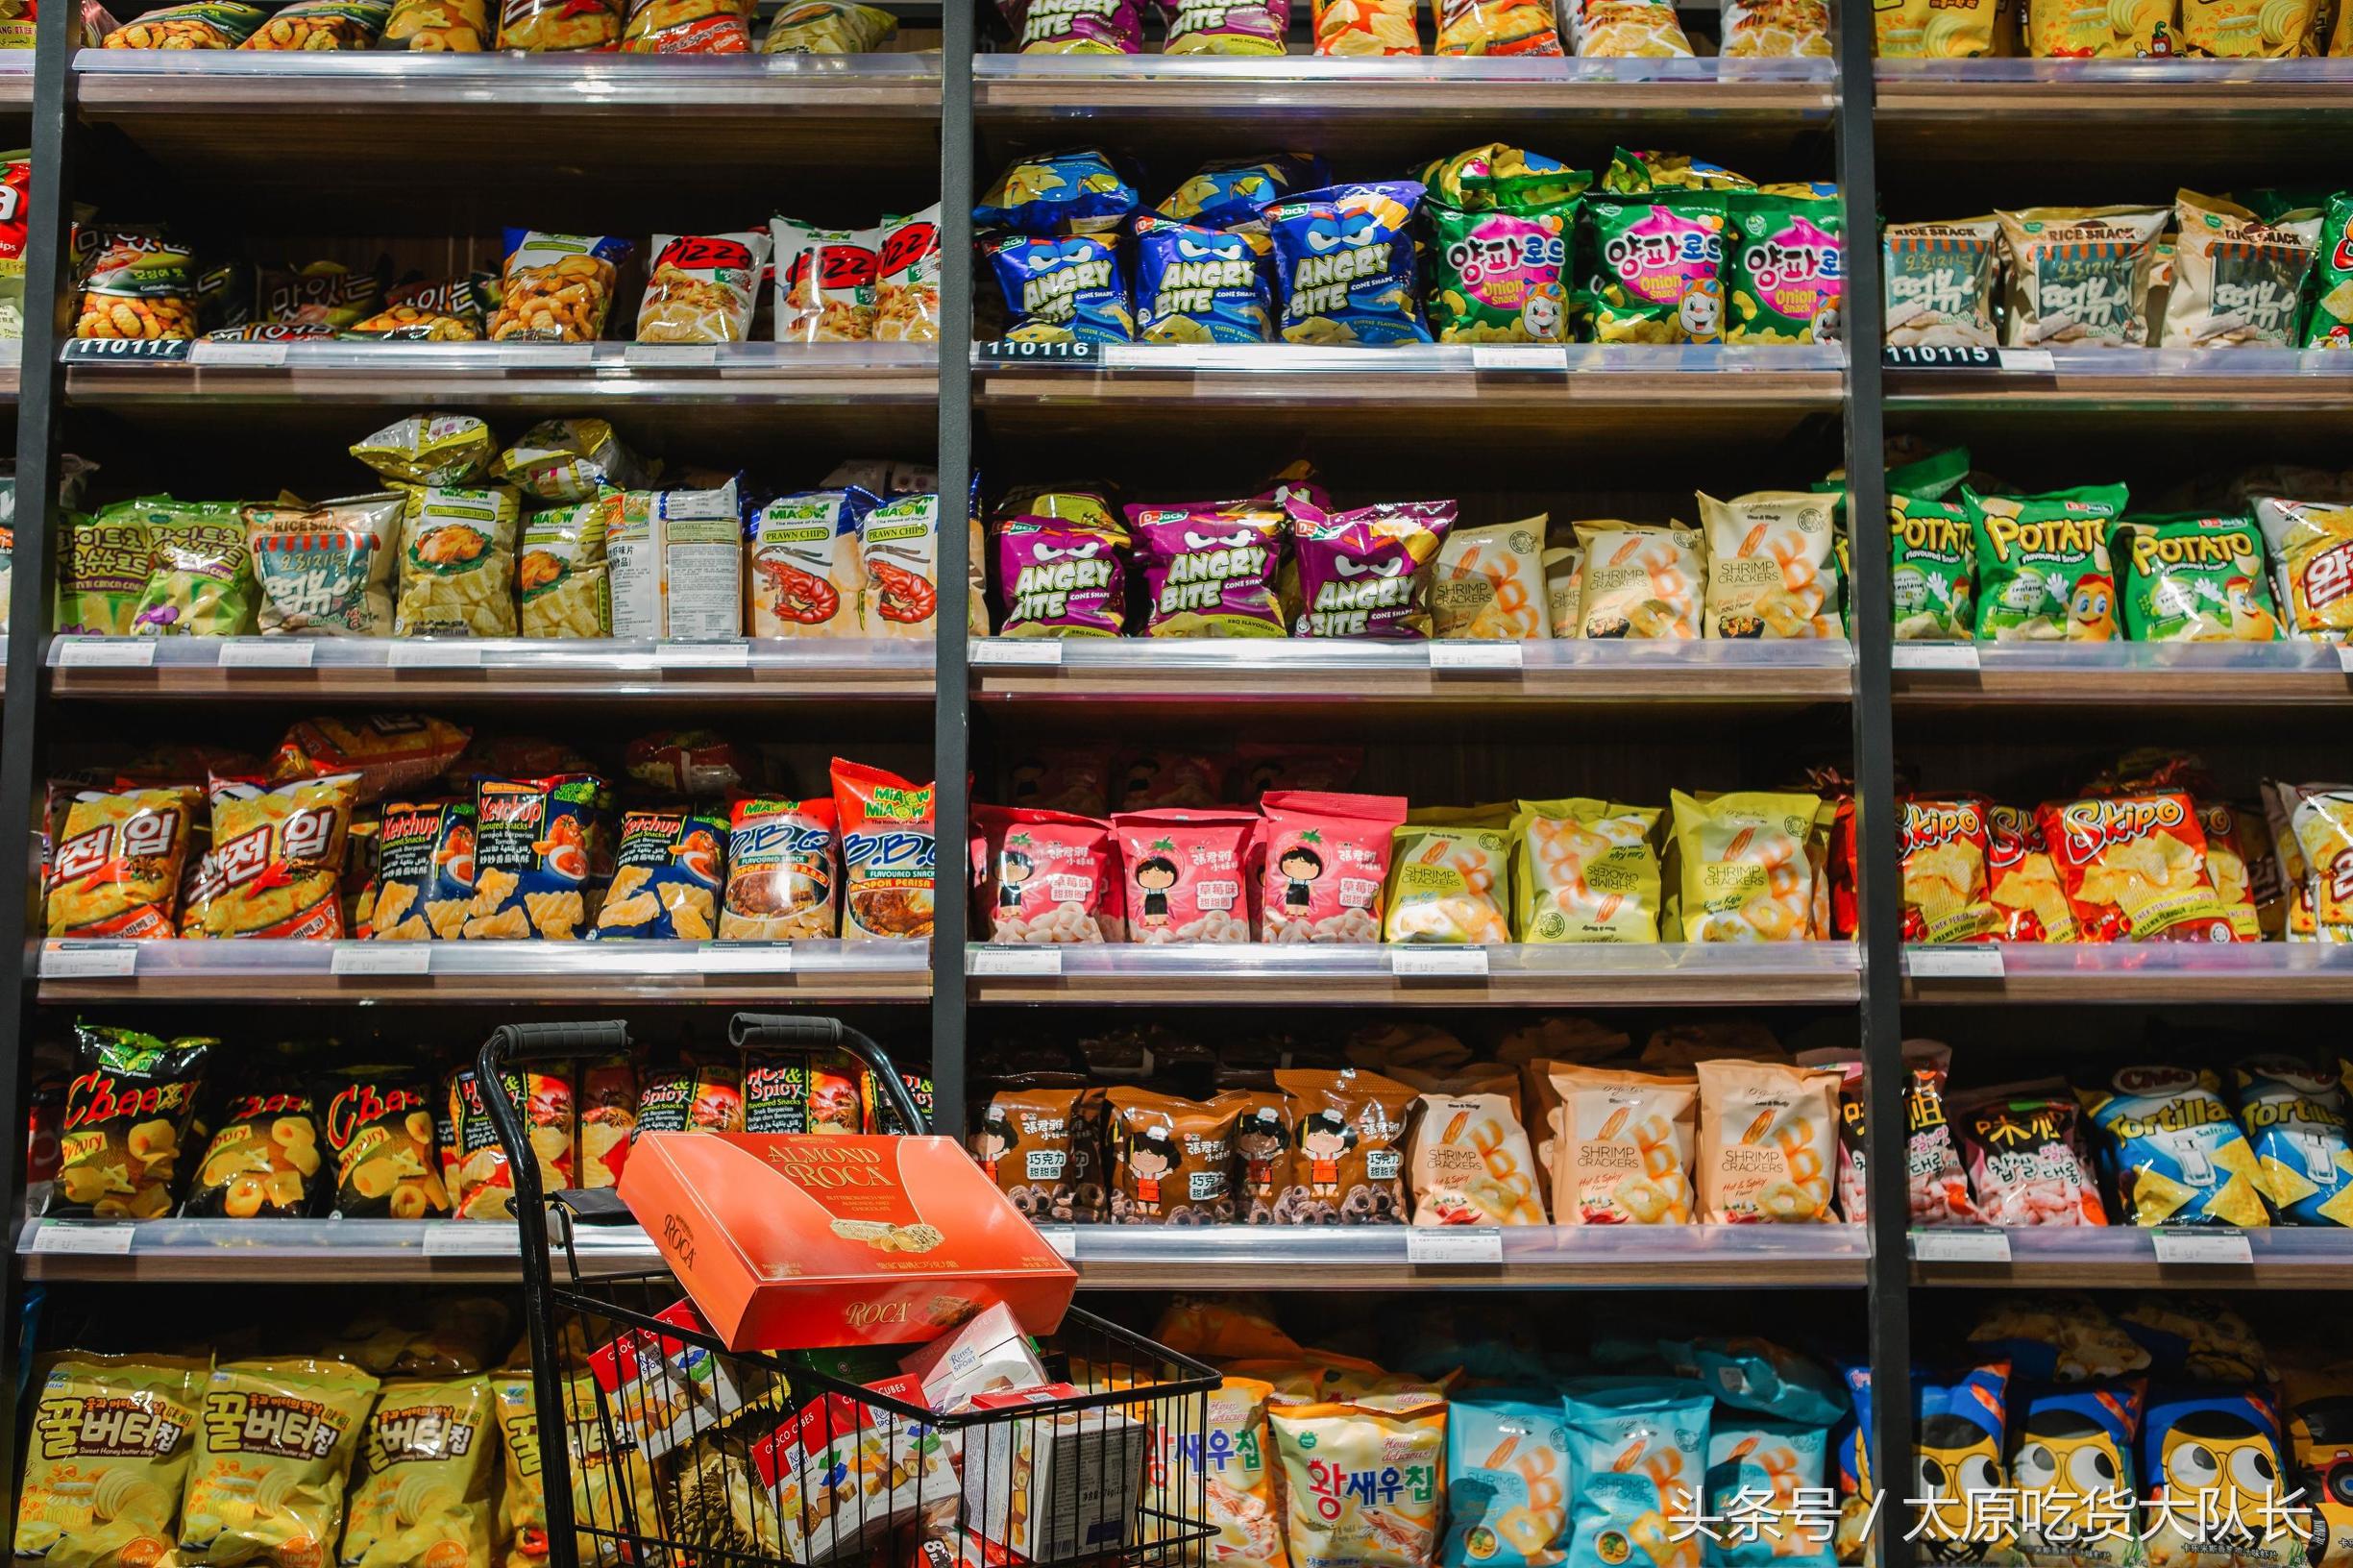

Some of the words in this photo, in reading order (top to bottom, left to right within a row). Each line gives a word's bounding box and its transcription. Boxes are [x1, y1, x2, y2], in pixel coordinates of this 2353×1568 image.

[2048, 229, 2082, 241] RICE
[1294, 243, 1392, 289] ANGRY
[1160, 261, 1255, 290] ANGRY
[1023, 260, 1114, 313] ANGRY
[1351, 281, 1372, 290] CONE
[1482, 281, 1524, 297] Onion
[1639, 275, 1682, 292] Onion
[1155, 289, 1213, 315] BITE
[1288, 282, 1348, 317] BITE
[1491, 292, 1520, 306] Snack
[1649, 287, 1678, 302] Snack
[1775, 289, 1818, 306] Onion
[1782, 303, 1812, 315] Snack
[987, 342, 1090, 356] 110116
[1885, 346, 1990, 362] 110115
[766, 531, 798, 541] PRAWN
[799, 529, 826, 539] CHIPS
[869, 528, 900, 540] PRAWN
[901, 526, 925, 536] CHIPS
[2022, 551, 2061, 564] Flavoured
[2063, 551, 2086, 562] Snack
[2132, 533, 2253, 576] POTATO
[1168, 546, 1268, 582] ANGRY
[1721, 561, 1775, 575] SHRIMP
[1016, 561, 1115, 593] ANGRY
[1589, 569, 1646, 582] SHRIMP
[1718, 573, 1778, 584] CRACKERS
[1225, 580, 1246, 589] CONE
[1437, 583, 1488, 597] SHRIMP
[1589, 578, 1648, 591] CRACKERS
[1160, 581, 1222, 612] BITE
[1315, 576, 1416, 611] ANGRY
[1434, 594, 1492, 606] CRACKERS
[874, 787, 931, 803] MIAOW
[480, 796, 542, 828] Ketchup
[866, 803, 926, 818] MIAOW
[382, 812, 439, 843] Ketchup
[625, 816, 680, 838] Ketchup
[2066, 797, 2184, 865] Skipo
[742, 855, 779, 864] FLAVOURED
[1405, 866, 1456, 880] SHRIMP
[1707, 865, 1761, 878] SHRIMP
[895, 879, 931, 888] PERISA
[1198, 881, 1238, 896] 草莓味
[1401, 875, 1460, 887] CRACKERS
[1589, 877, 1637, 892] SHRIMP
[1703, 875, 1764, 888] CRACKERS
[750, 1080, 802, 1100] Spicy
[1021, 1119, 1065, 1135] 張君雅
[769, 1145, 881, 1164] ALMOND
[1028, 1152, 1065, 1165] 巧克力
[1428, 1149, 1477, 1164] SHRIMP
[1581, 1145, 1635, 1159] SHRIMP
[1725, 1150, 1779, 1164] SHRIMP
[1427, 1160, 1483, 1170] CRACKERS
[1577, 1157, 1639, 1168] CRACKERS
[1722, 1162, 1783, 1173] CRACKERS
[785, 1164, 897, 1188] ROCA
[663, 1214, 697, 1272] ROCA
[846, 1301, 911, 1327] ROCA
[949, 1346, 974, 1365] Ritter
[953, 1355, 977, 1371] SPORT
[878, 1383, 906, 1395] CUBES
[1307, 1459, 1434, 1521] 왕새우칩
